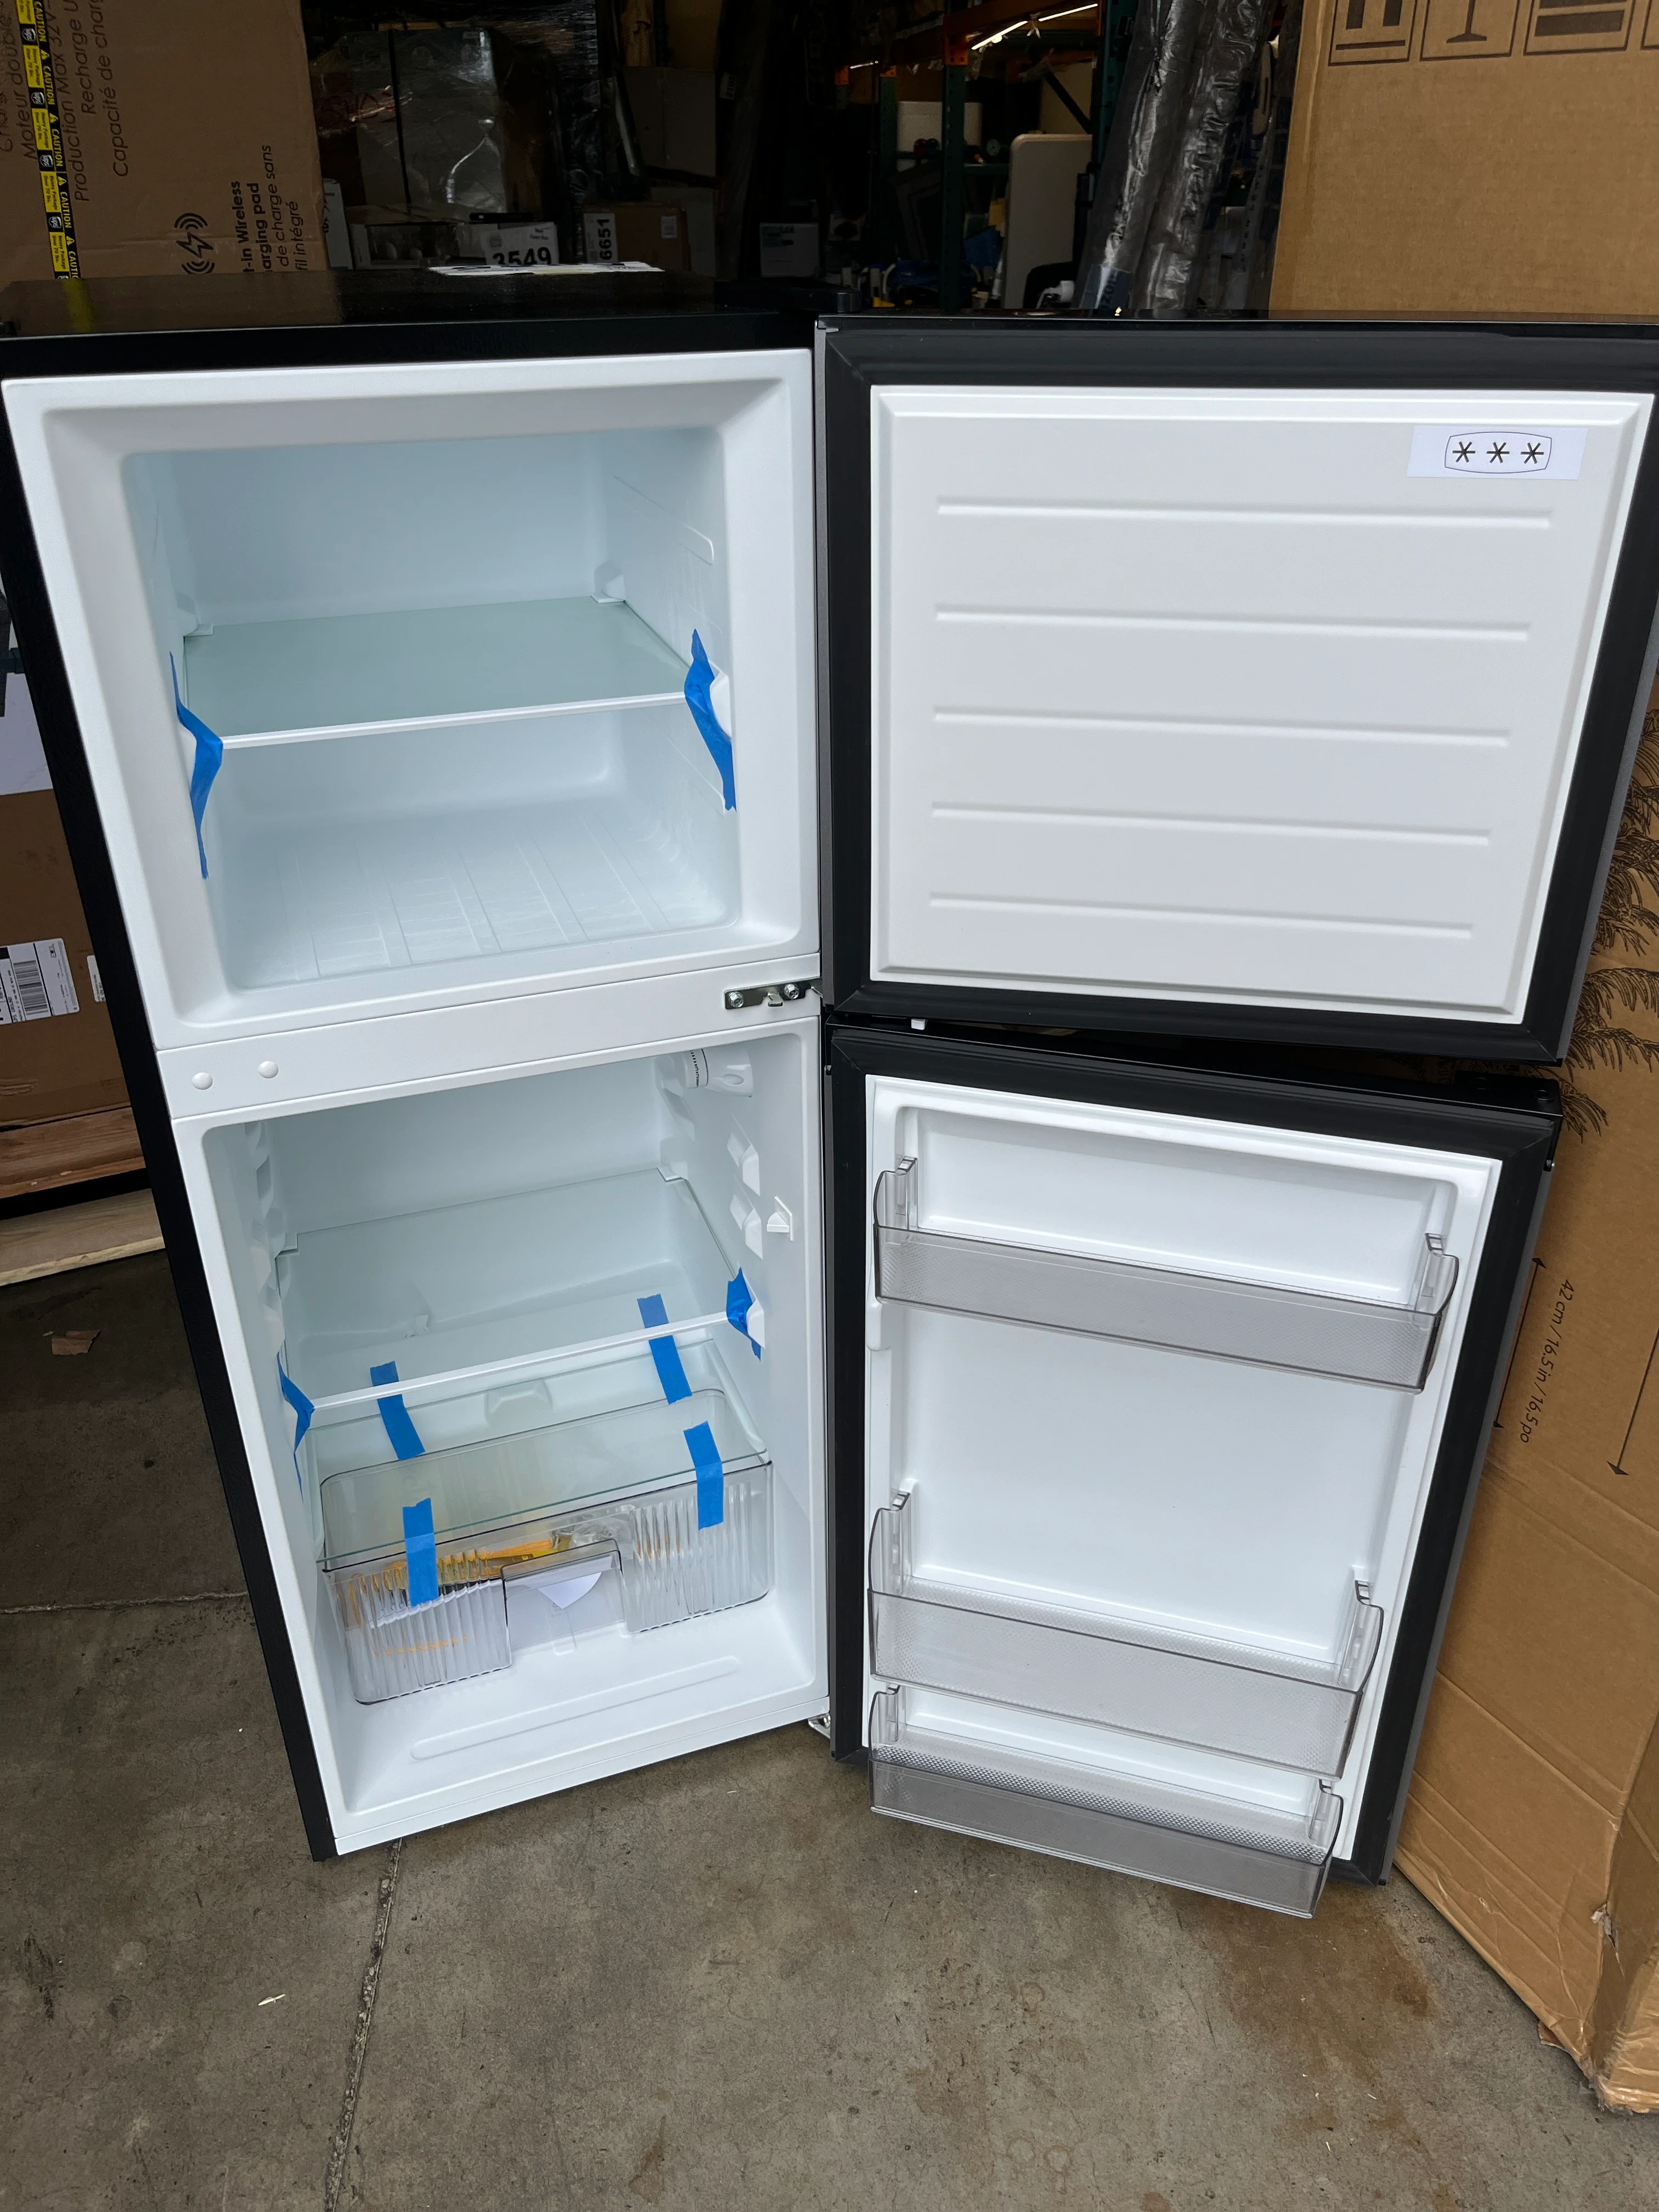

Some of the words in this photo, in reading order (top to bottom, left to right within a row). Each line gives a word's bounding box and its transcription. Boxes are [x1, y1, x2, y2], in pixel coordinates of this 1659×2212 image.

[34, 1, 47, 42] CAUTION
[43, 65, 55, 105] CAUTION
[54, 52, 71, 94] Max
[70, 19, 97, 114] Recharge
[97, 55, 113, 81] de
[13, 90, 37, 159] Moteur
[99, 87, 128, 177] Capacité
[52, 128, 63, 167] CAUTION
[61, 101, 89, 201] Production
[262, 145, 275, 180] sans
[60, 191, 72, 228] CAUTION
[231, 180, 249, 244] Wireless
[246, 183, 266, 215] pad
[268, 184, 285, 242] charge
[285, 201, 307, 256] intégré
[597, 218, 613, 260] 6651
[276, 245, 289, 267] de
[295, 258, 308, 271] fil
